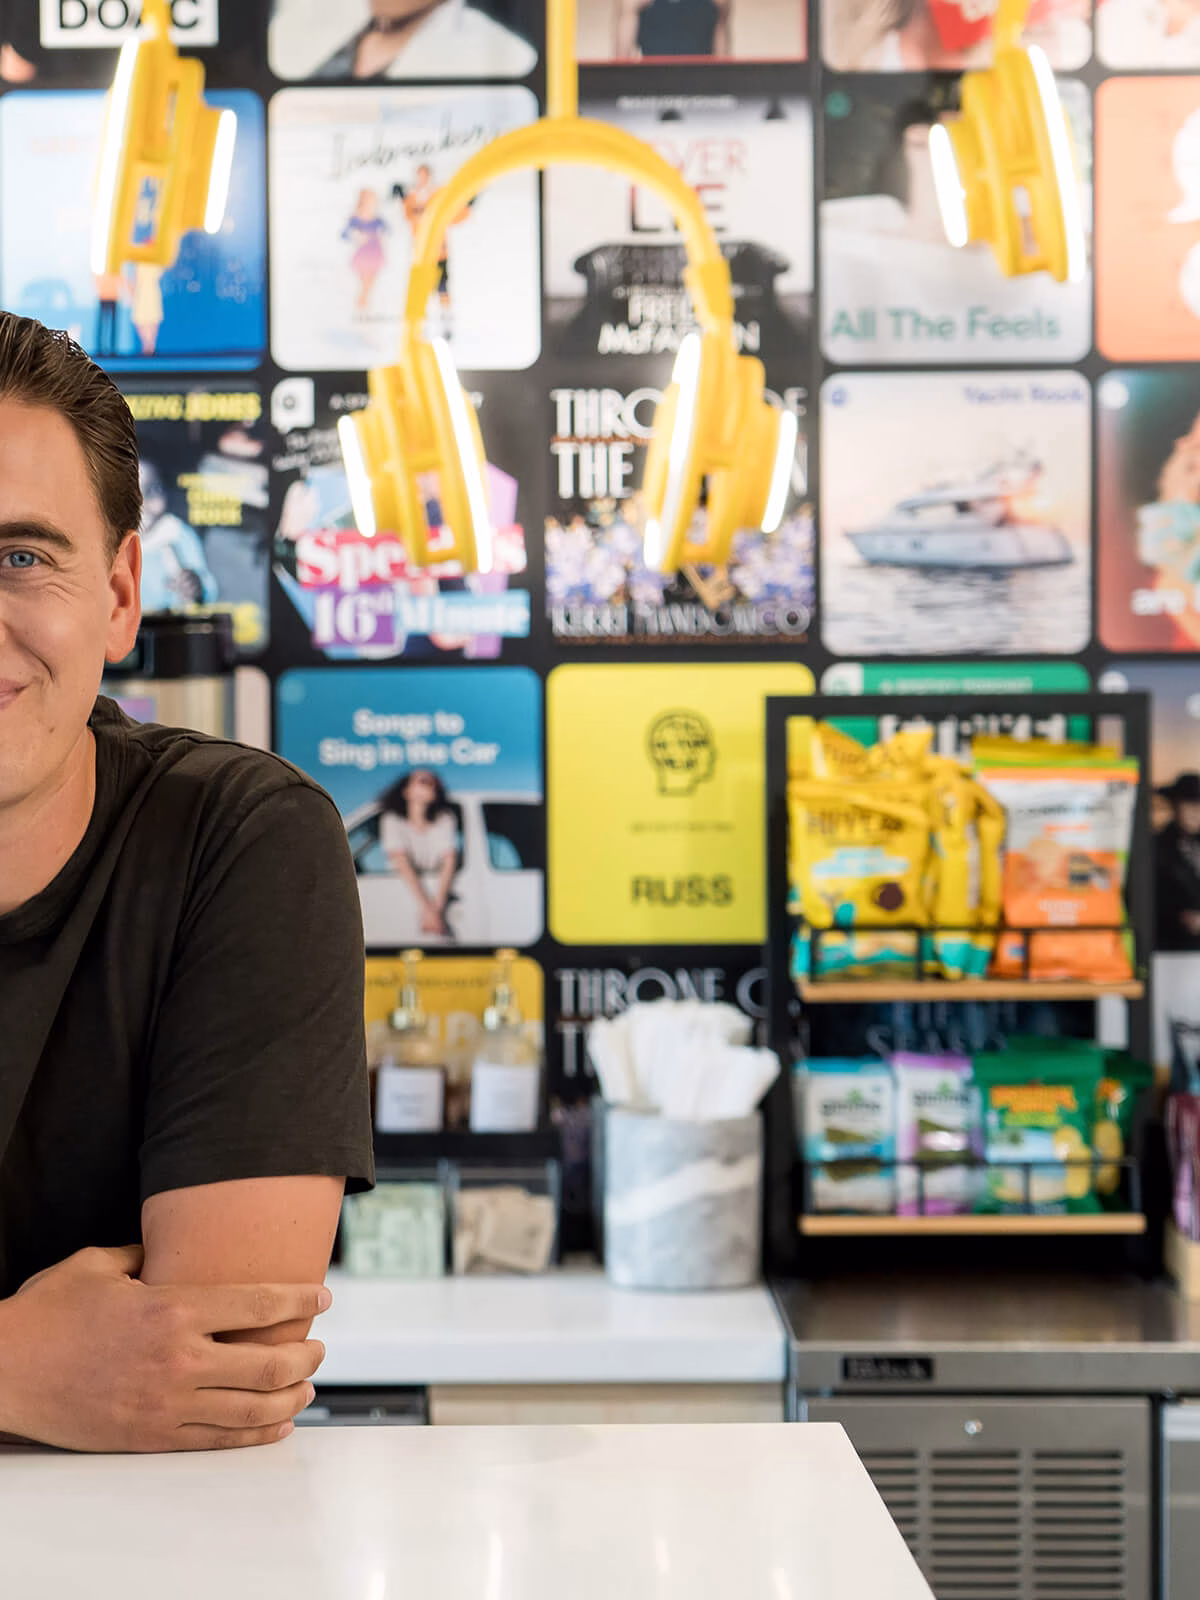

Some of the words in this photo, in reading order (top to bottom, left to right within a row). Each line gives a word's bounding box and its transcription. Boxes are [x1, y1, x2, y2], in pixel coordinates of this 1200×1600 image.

[59, 0, 200, 30] DOC
[831, 308, 877, 339] All
[888, 306, 955, 339] The
[967, 305, 1061, 338] Feels
[550, 387, 667, 438] THRO
[550, 442, 635, 499] THE
[353, 708, 433, 741] Songs
[434, 711, 465, 737] to
[319, 737, 377, 771] Sing
[378, 737, 404, 765] in
[405, 739, 448, 765] the
[450, 736, 500, 765] Car
[631, 876, 734, 907] RUSS
